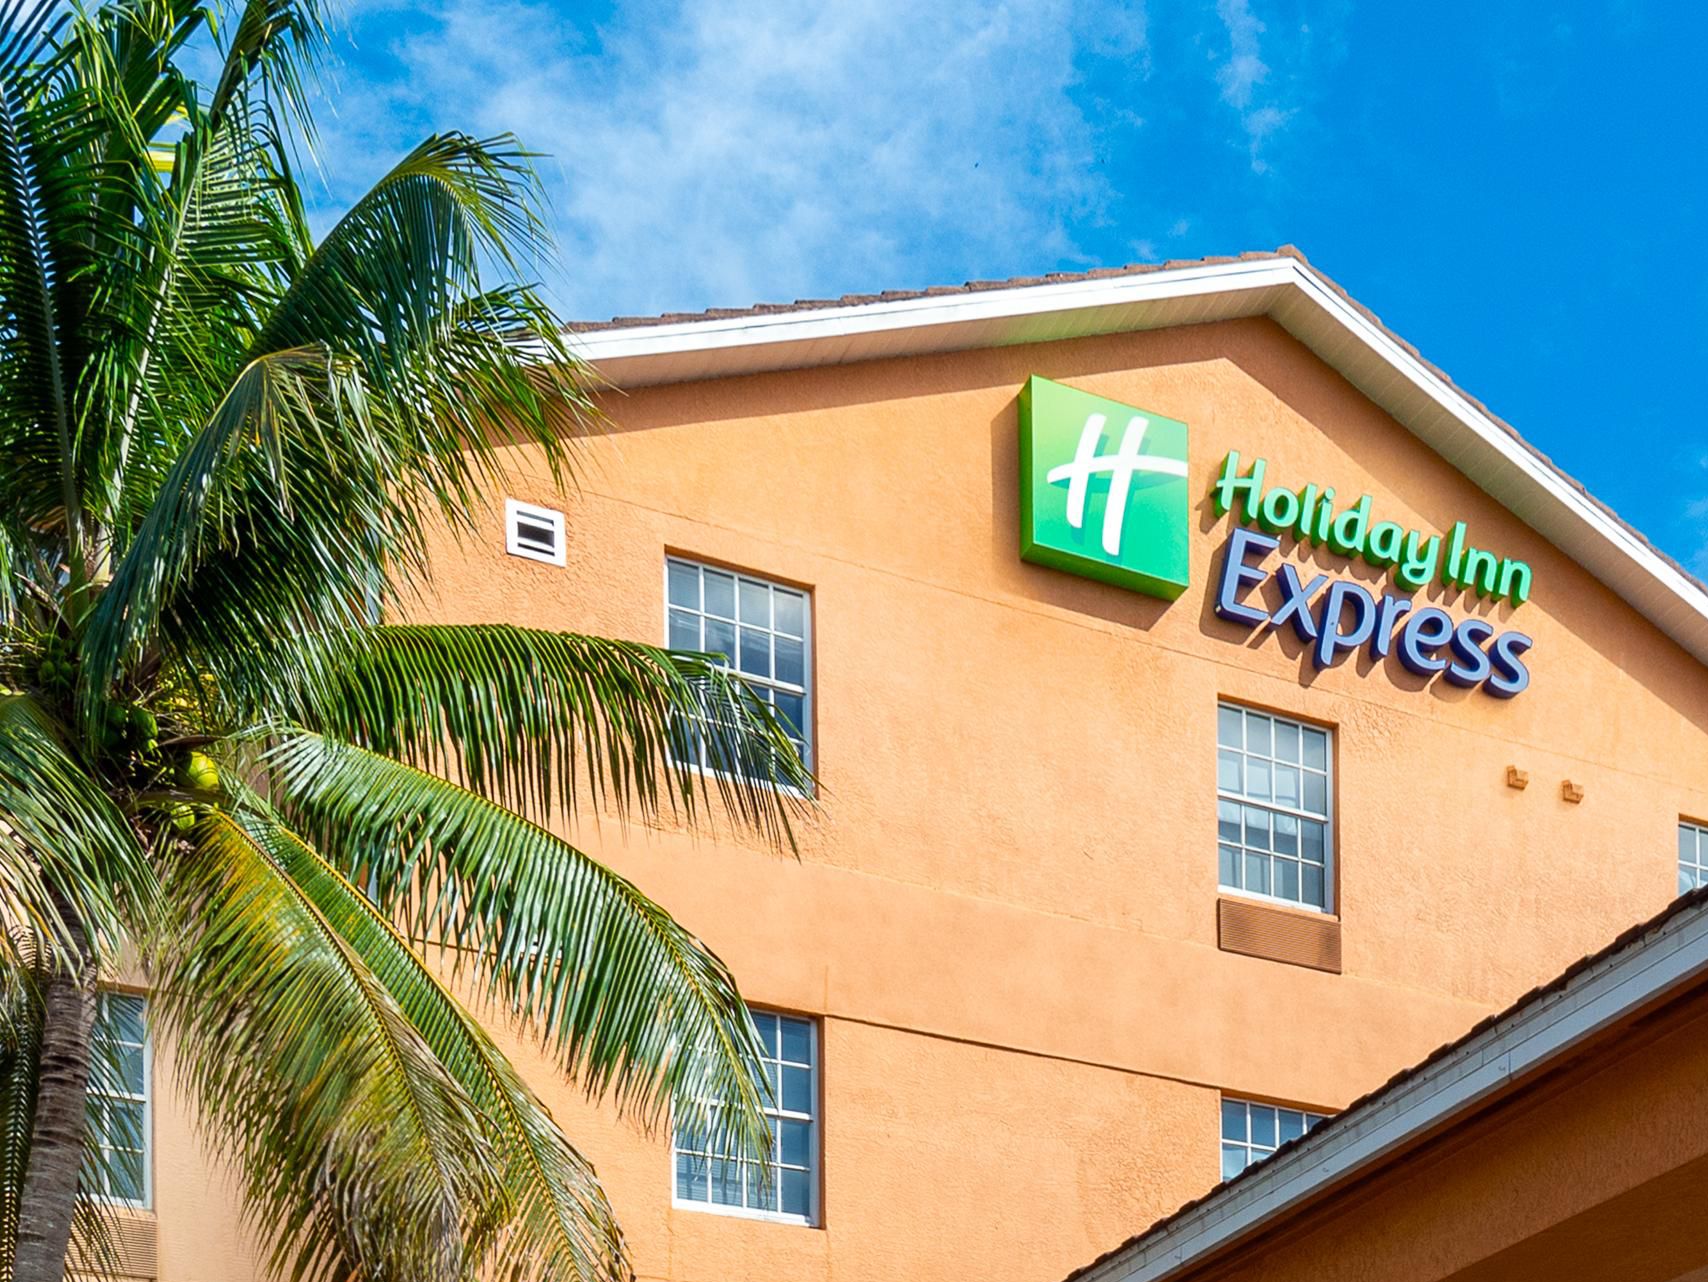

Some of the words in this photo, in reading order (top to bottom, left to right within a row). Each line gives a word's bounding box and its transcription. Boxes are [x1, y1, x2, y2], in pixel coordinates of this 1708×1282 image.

[1216, 450, 1440, 591] Holiday
[1442, 521, 1533, 608] Inn
[1216, 528, 1533, 699] Express
